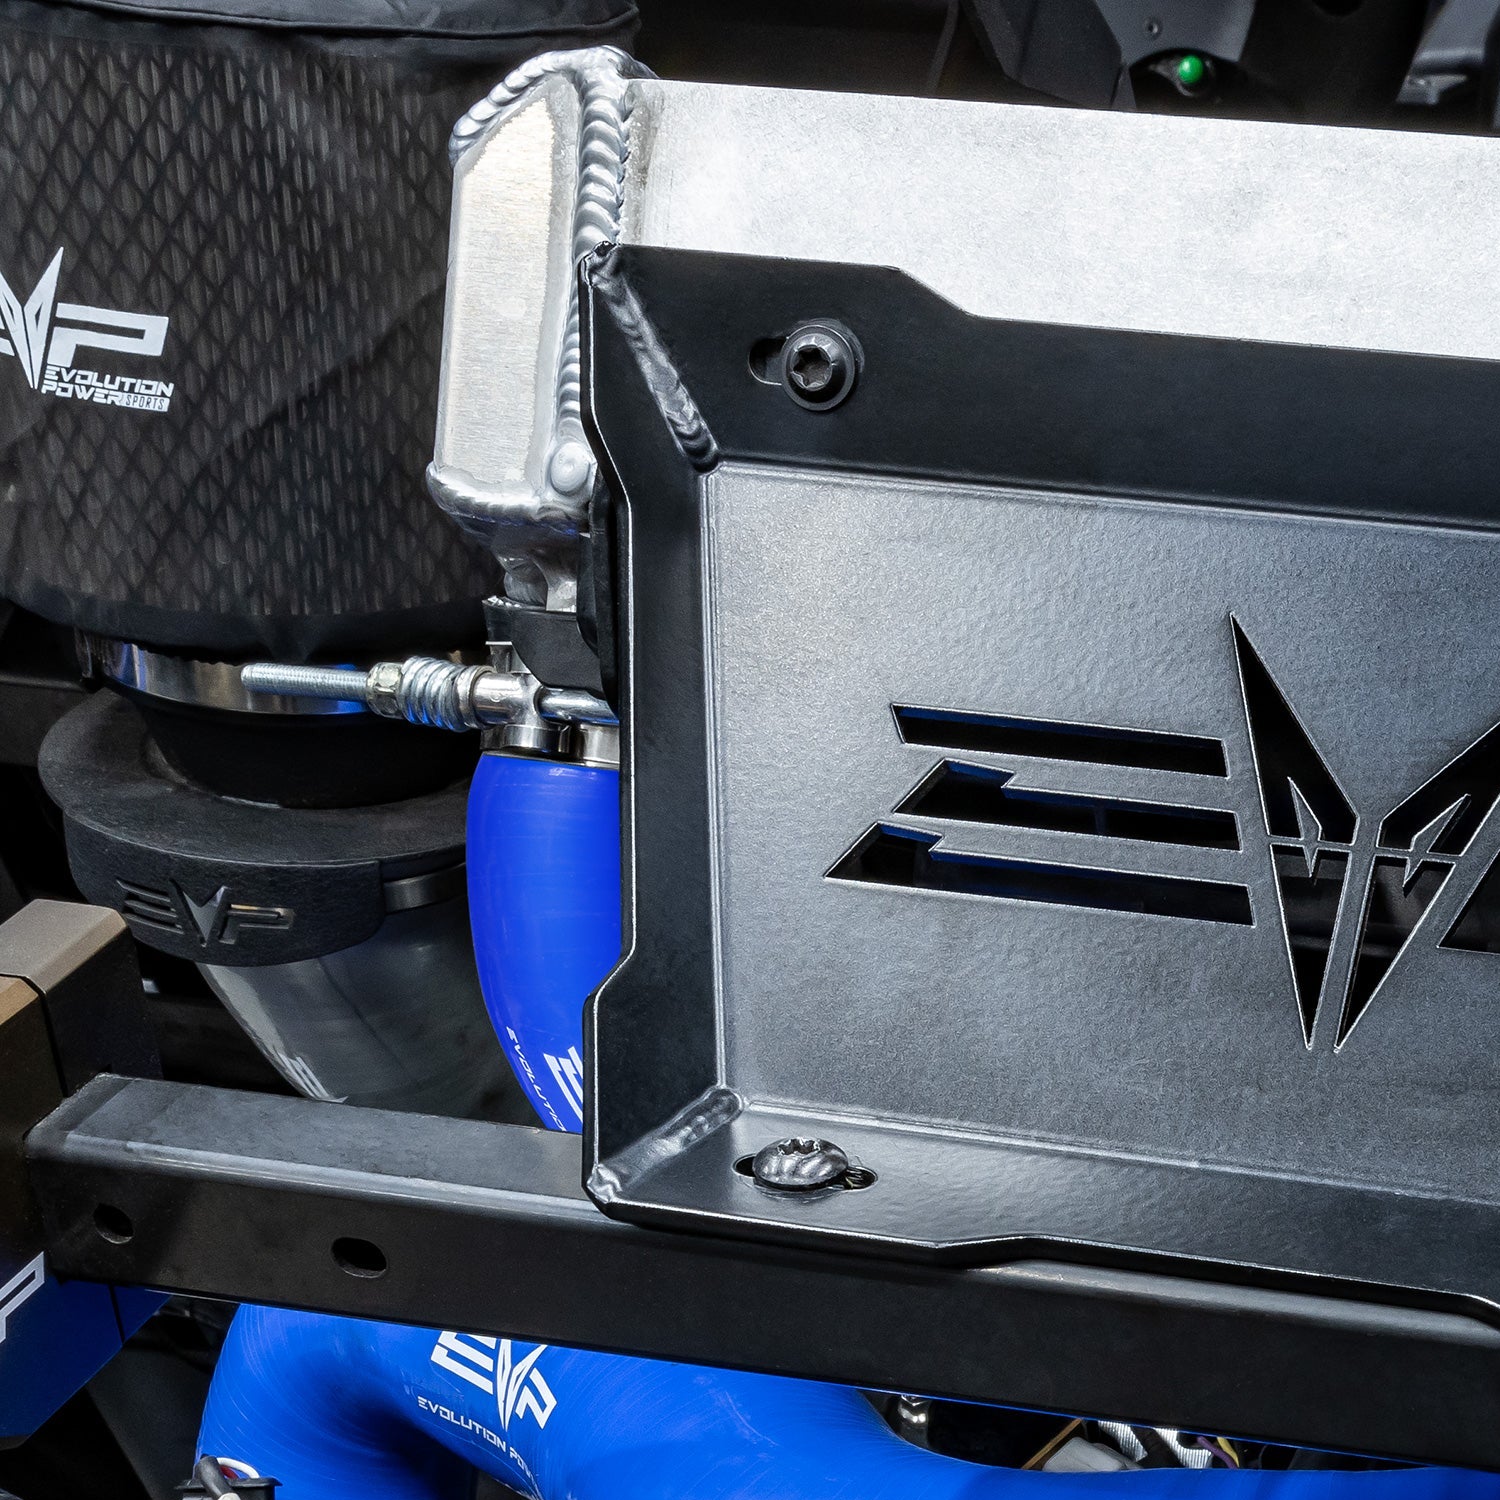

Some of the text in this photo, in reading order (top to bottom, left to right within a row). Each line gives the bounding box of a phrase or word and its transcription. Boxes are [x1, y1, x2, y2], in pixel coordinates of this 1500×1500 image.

[0, 247, 169, 390] VP
[44, 365, 175, 397] EVOLUTION
[116, 877, 295, 948] EVP
[417, 1395, 507, 1453] EVOLUTION
